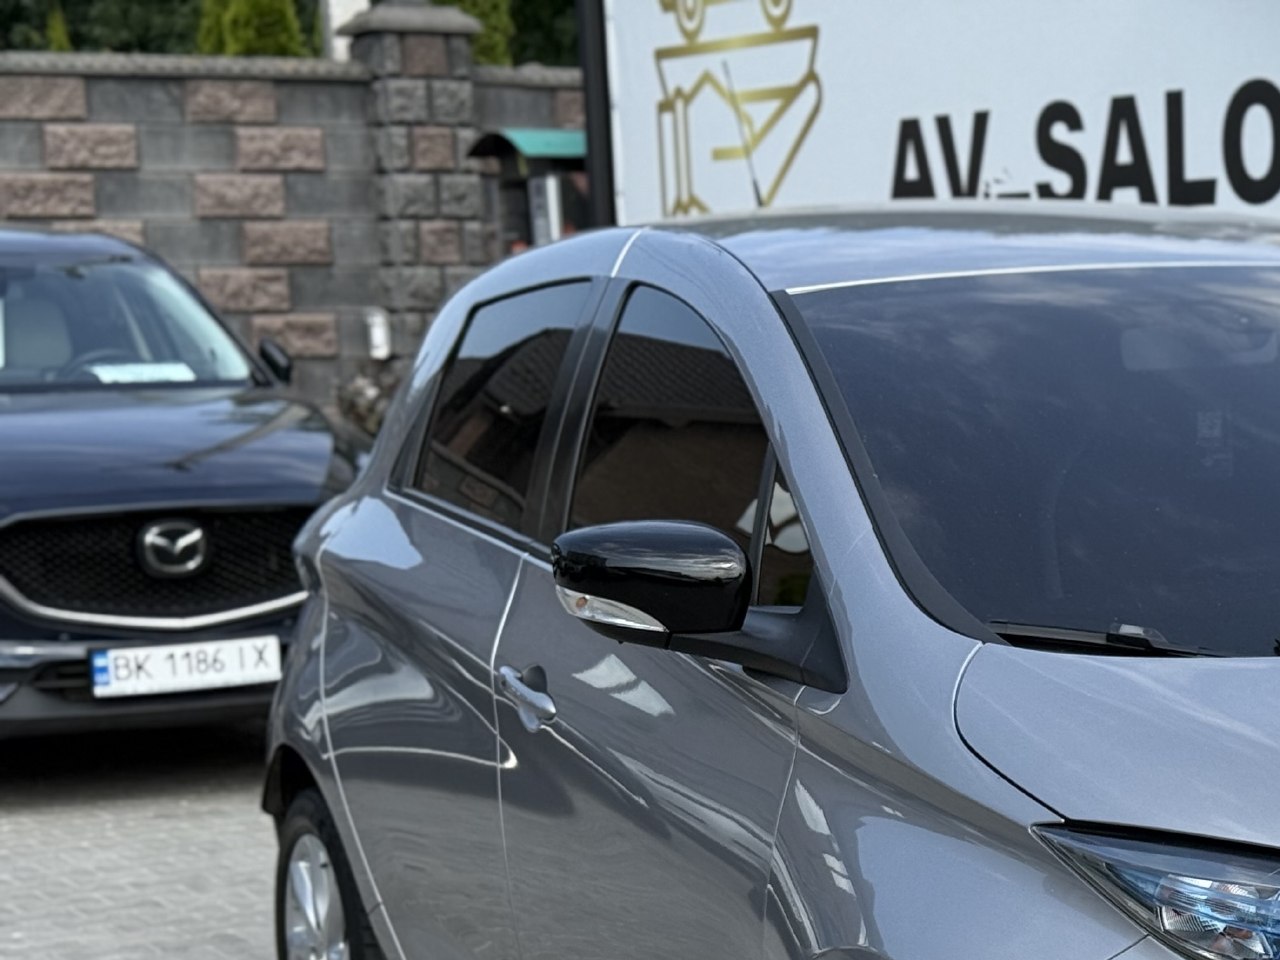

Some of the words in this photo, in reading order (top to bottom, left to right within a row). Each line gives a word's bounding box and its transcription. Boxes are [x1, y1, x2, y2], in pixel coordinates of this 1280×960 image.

[113, 653, 153, 681] BK
[164, 648, 226, 677] 1186
[238, 642, 270, 671] IX
